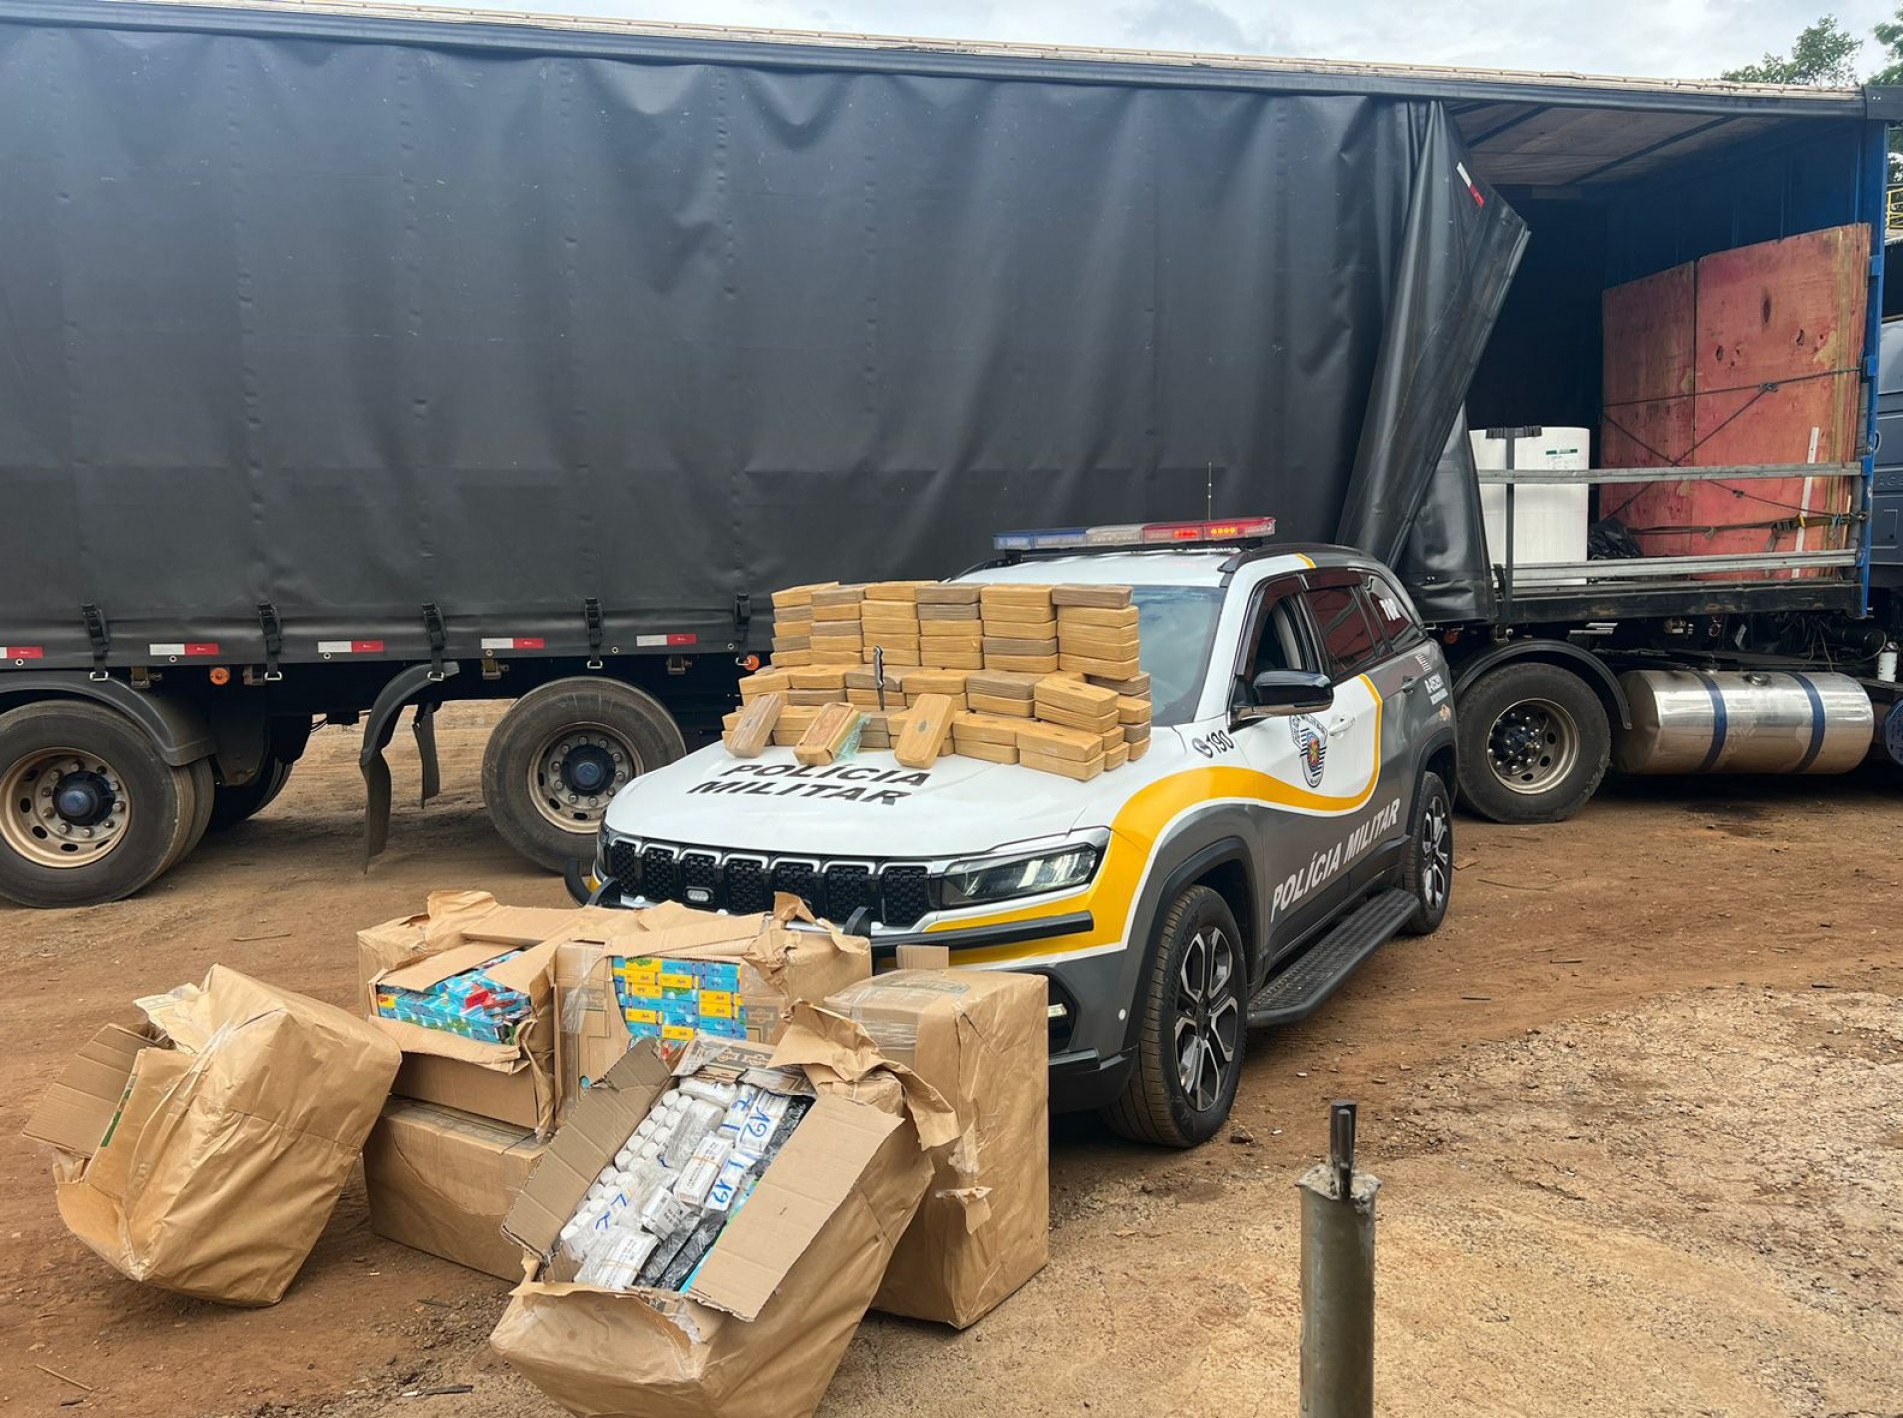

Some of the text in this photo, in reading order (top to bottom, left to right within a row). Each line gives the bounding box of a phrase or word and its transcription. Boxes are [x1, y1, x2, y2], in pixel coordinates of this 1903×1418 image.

[1205, 729, 1235, 754] 190
[718, 763, 931, 787] POLÍCIA
[686, 780, 912, 806] MILITAR
[1270, 798, 1400, 923] POLÍCIA MILITAR
